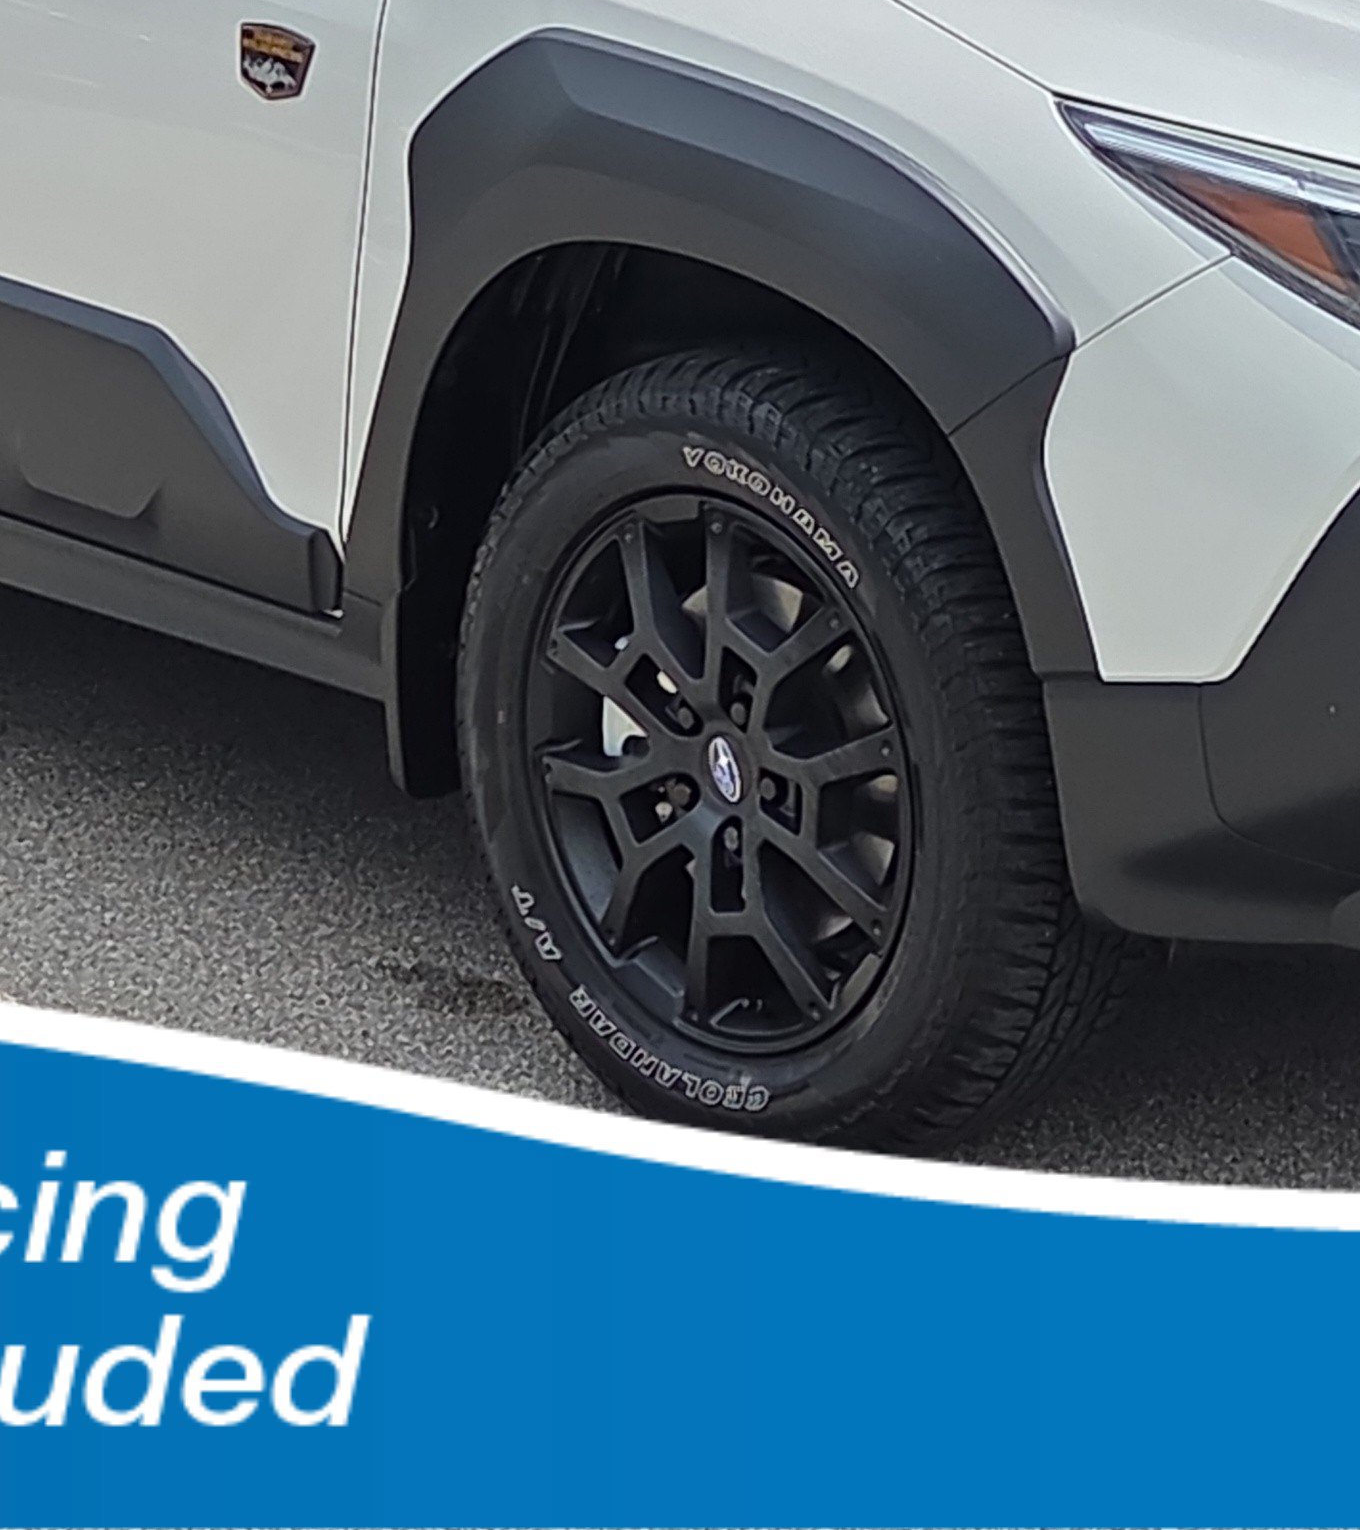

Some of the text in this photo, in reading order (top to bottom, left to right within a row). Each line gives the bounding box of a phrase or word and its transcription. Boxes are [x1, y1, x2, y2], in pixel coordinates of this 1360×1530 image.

[682, 446, 860, 589] YOKOHAMA
[510, 883, 771, 1111] GEOLANDAR A/T
